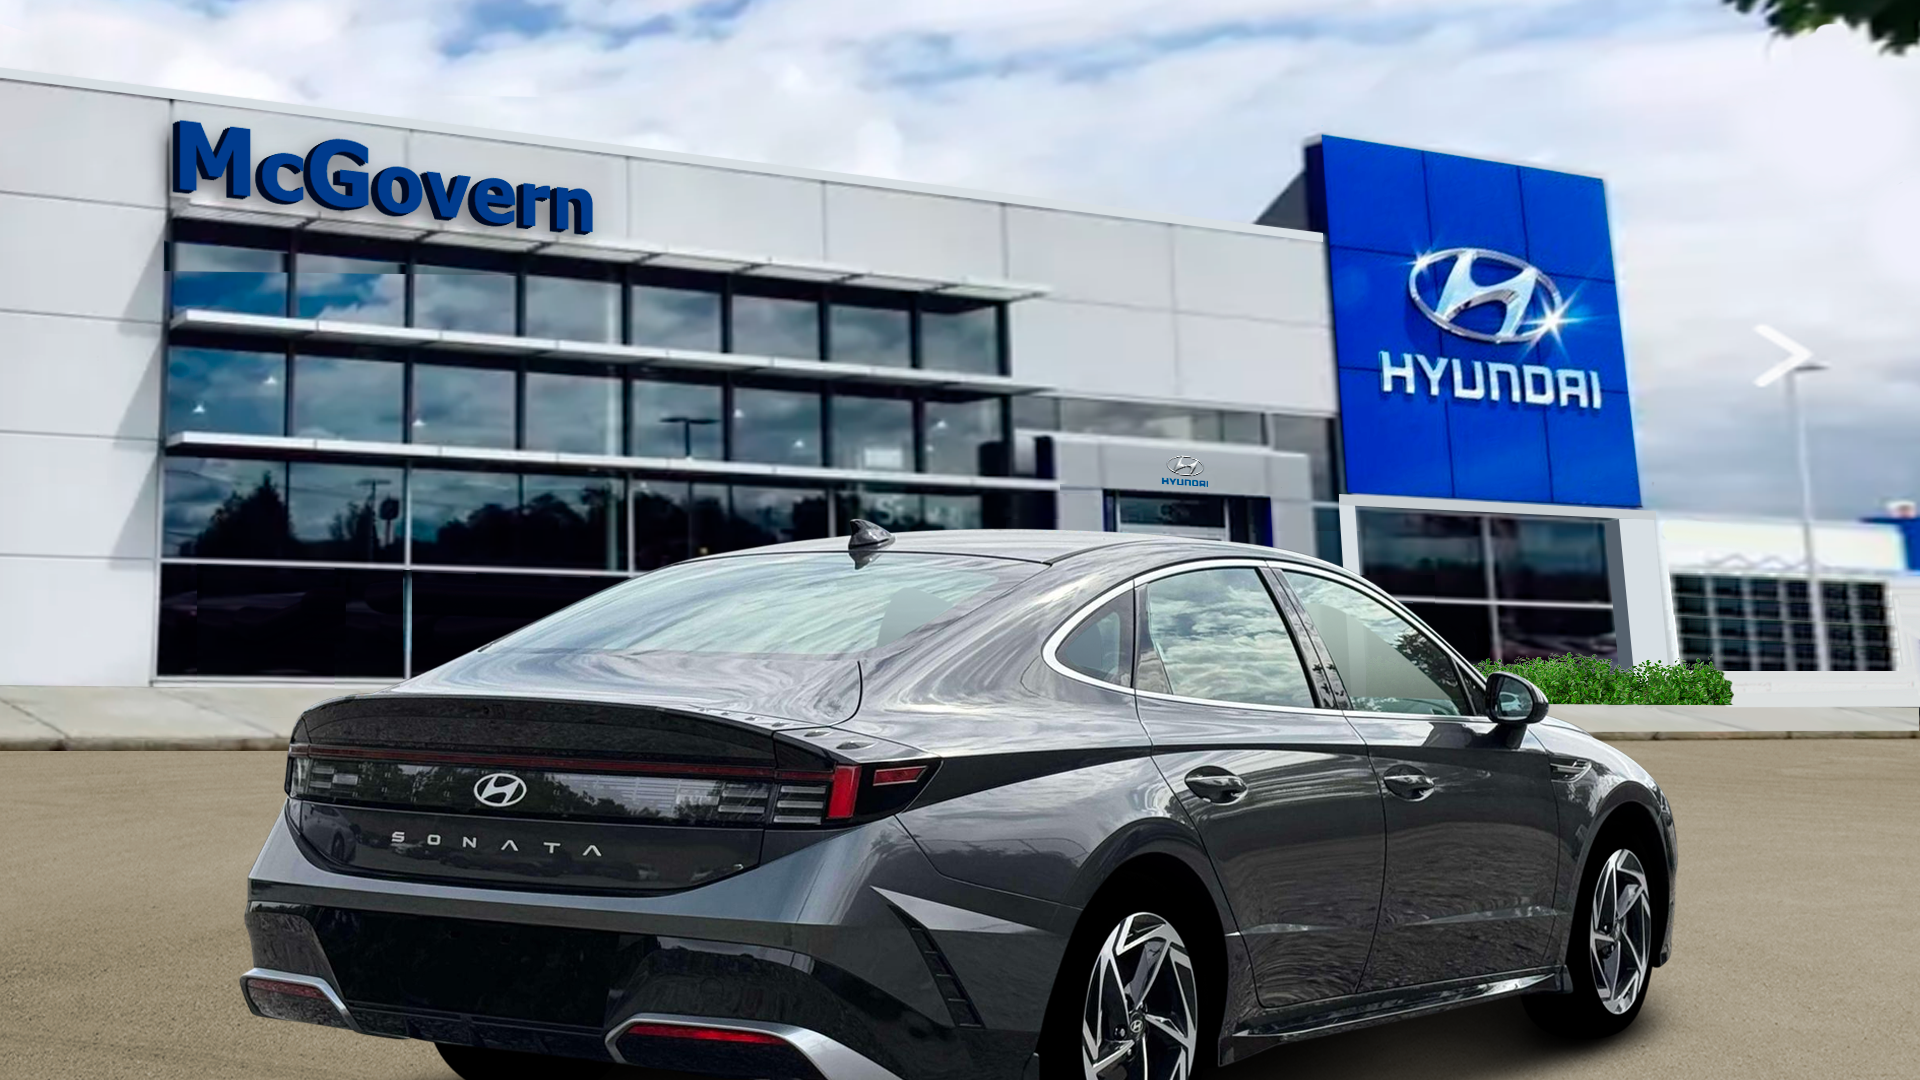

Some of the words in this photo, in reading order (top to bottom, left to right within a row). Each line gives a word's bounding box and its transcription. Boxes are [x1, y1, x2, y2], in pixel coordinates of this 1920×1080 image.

[172, 120, 594, 235] McGovern
[1379, 351, 1602, 409] HYUNDAI
[1161, 477, 1209, 488] HYUNDAI
